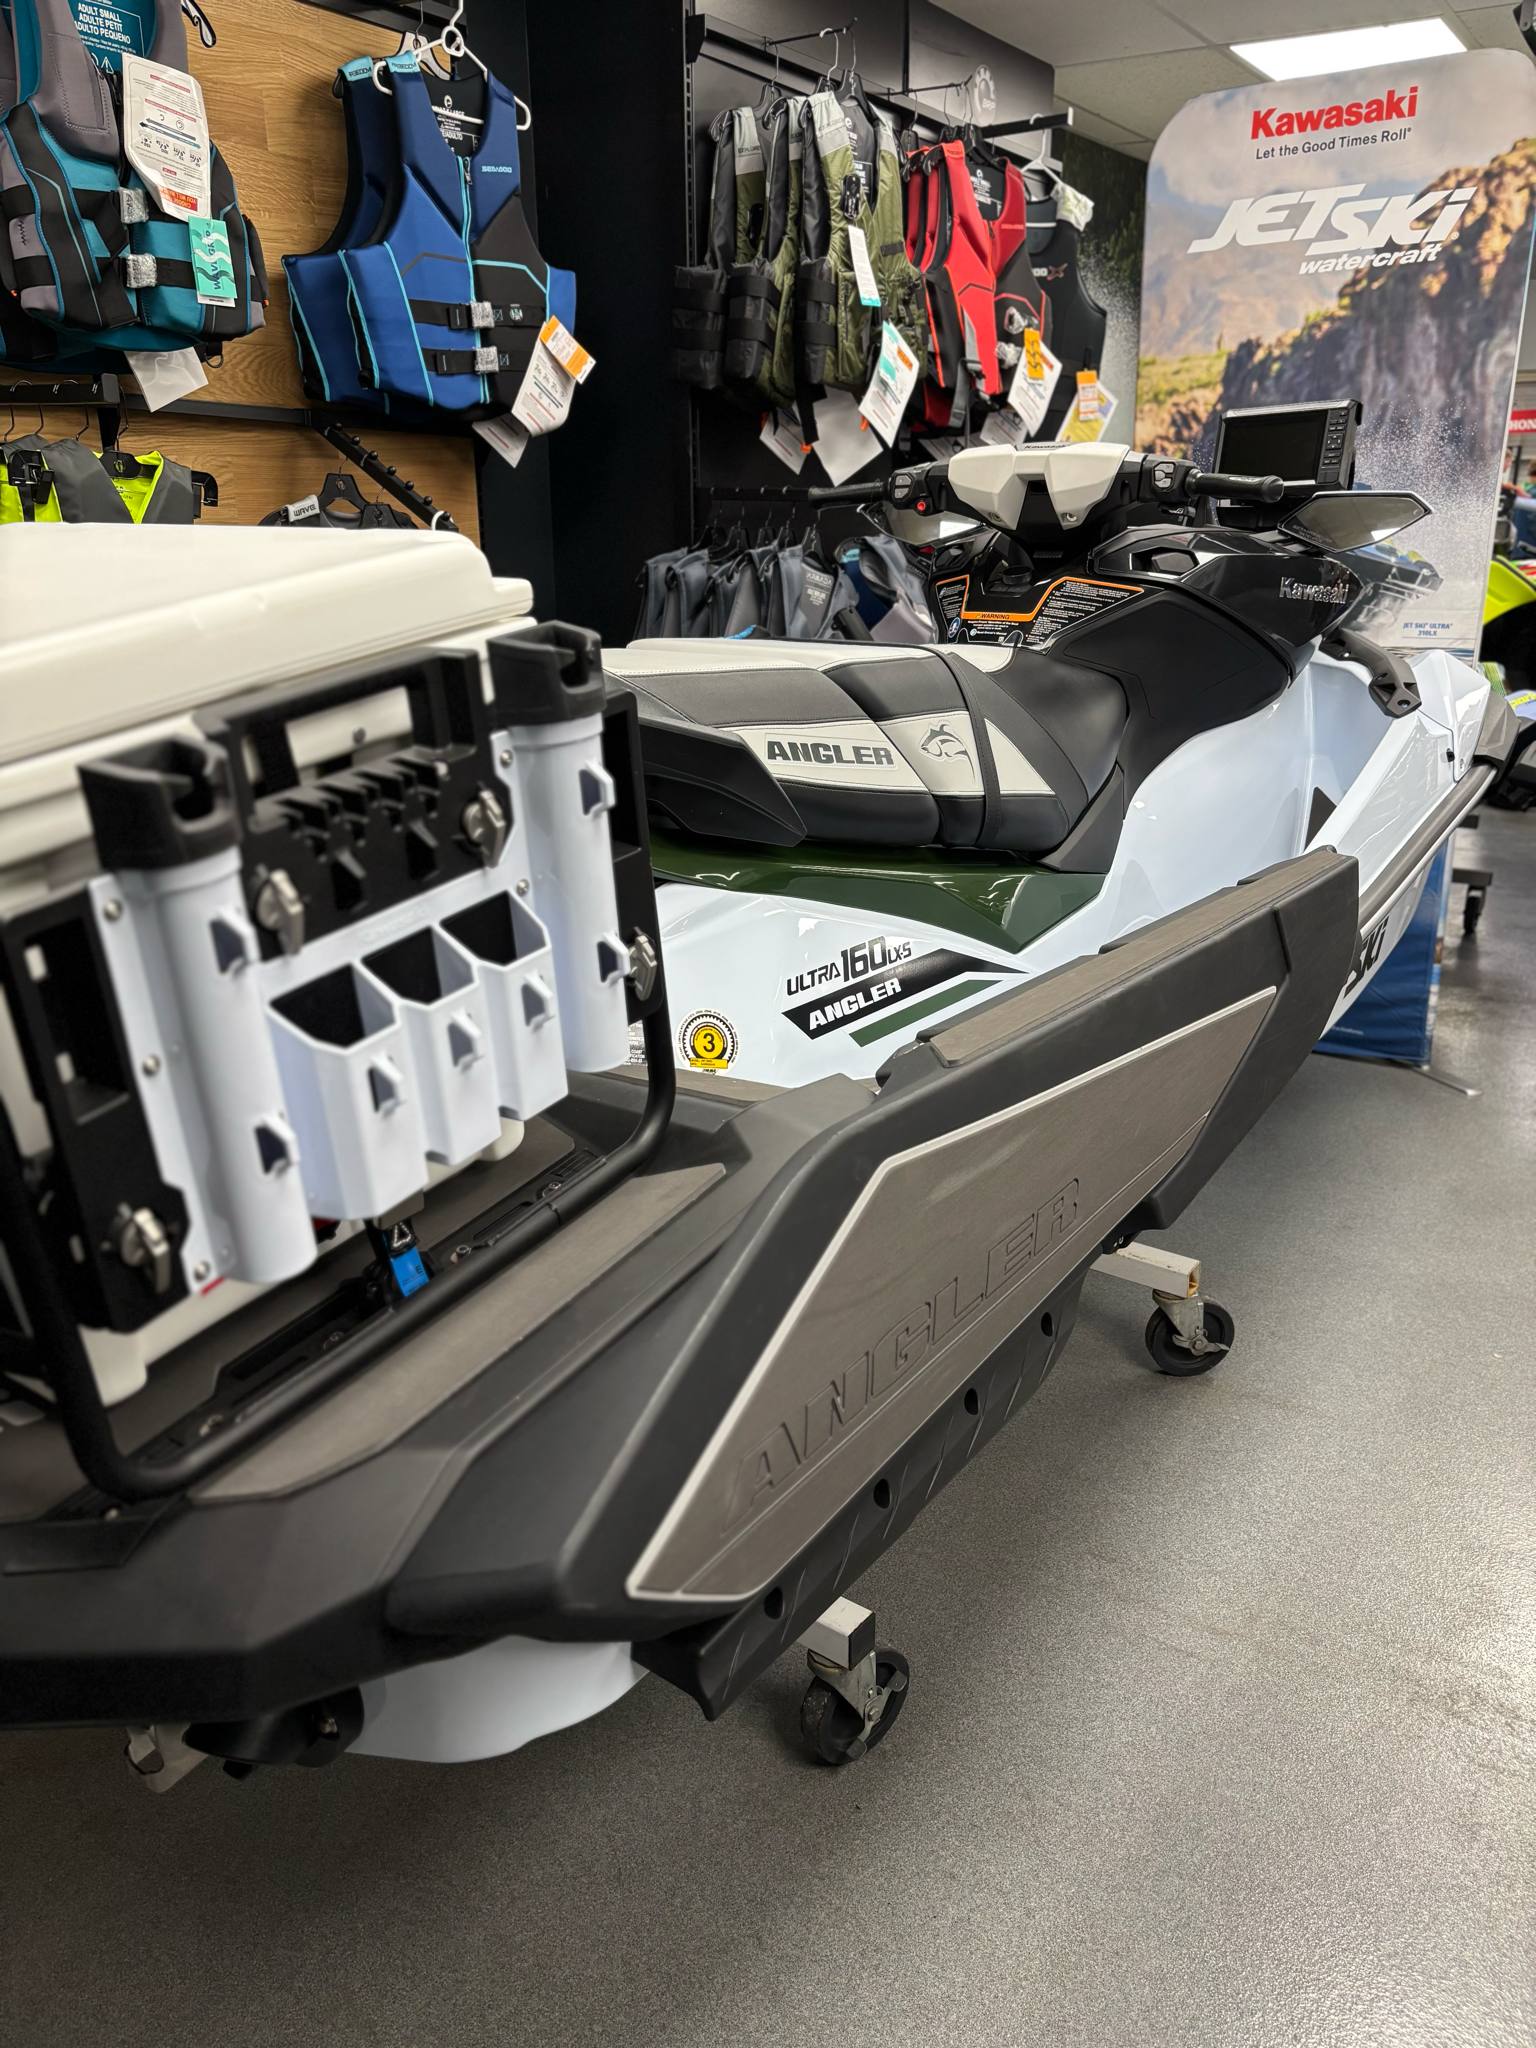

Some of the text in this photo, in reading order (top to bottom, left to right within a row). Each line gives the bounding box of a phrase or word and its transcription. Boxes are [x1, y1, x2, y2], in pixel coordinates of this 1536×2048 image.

[78, 3, 98, 16] ADULT
[99, 9, 122, 22] SMALL
[79, 13, 123, 32] ADULTE PETIT
[1251, 86, 1418, 140] Kawasaki
[1256, 148, 1275, 160] Let
[1279, 144, 1299, 156] the
[1302, 138, 1335, 153] Good
[1338, 133, 1378, 148] Times
[1298, 243, 1443, 275] watercraft
[1279, 576, 1349, 604] Kawasaki
[767, 740, 894, 765] ANGLER
[787, 962, 841, 996] ULTRA
[809, 977, 902, 1031] ANGLER
[703, 1032, 716, 1053] 3
[721, 1178, 1079, 1538] ANGLER
